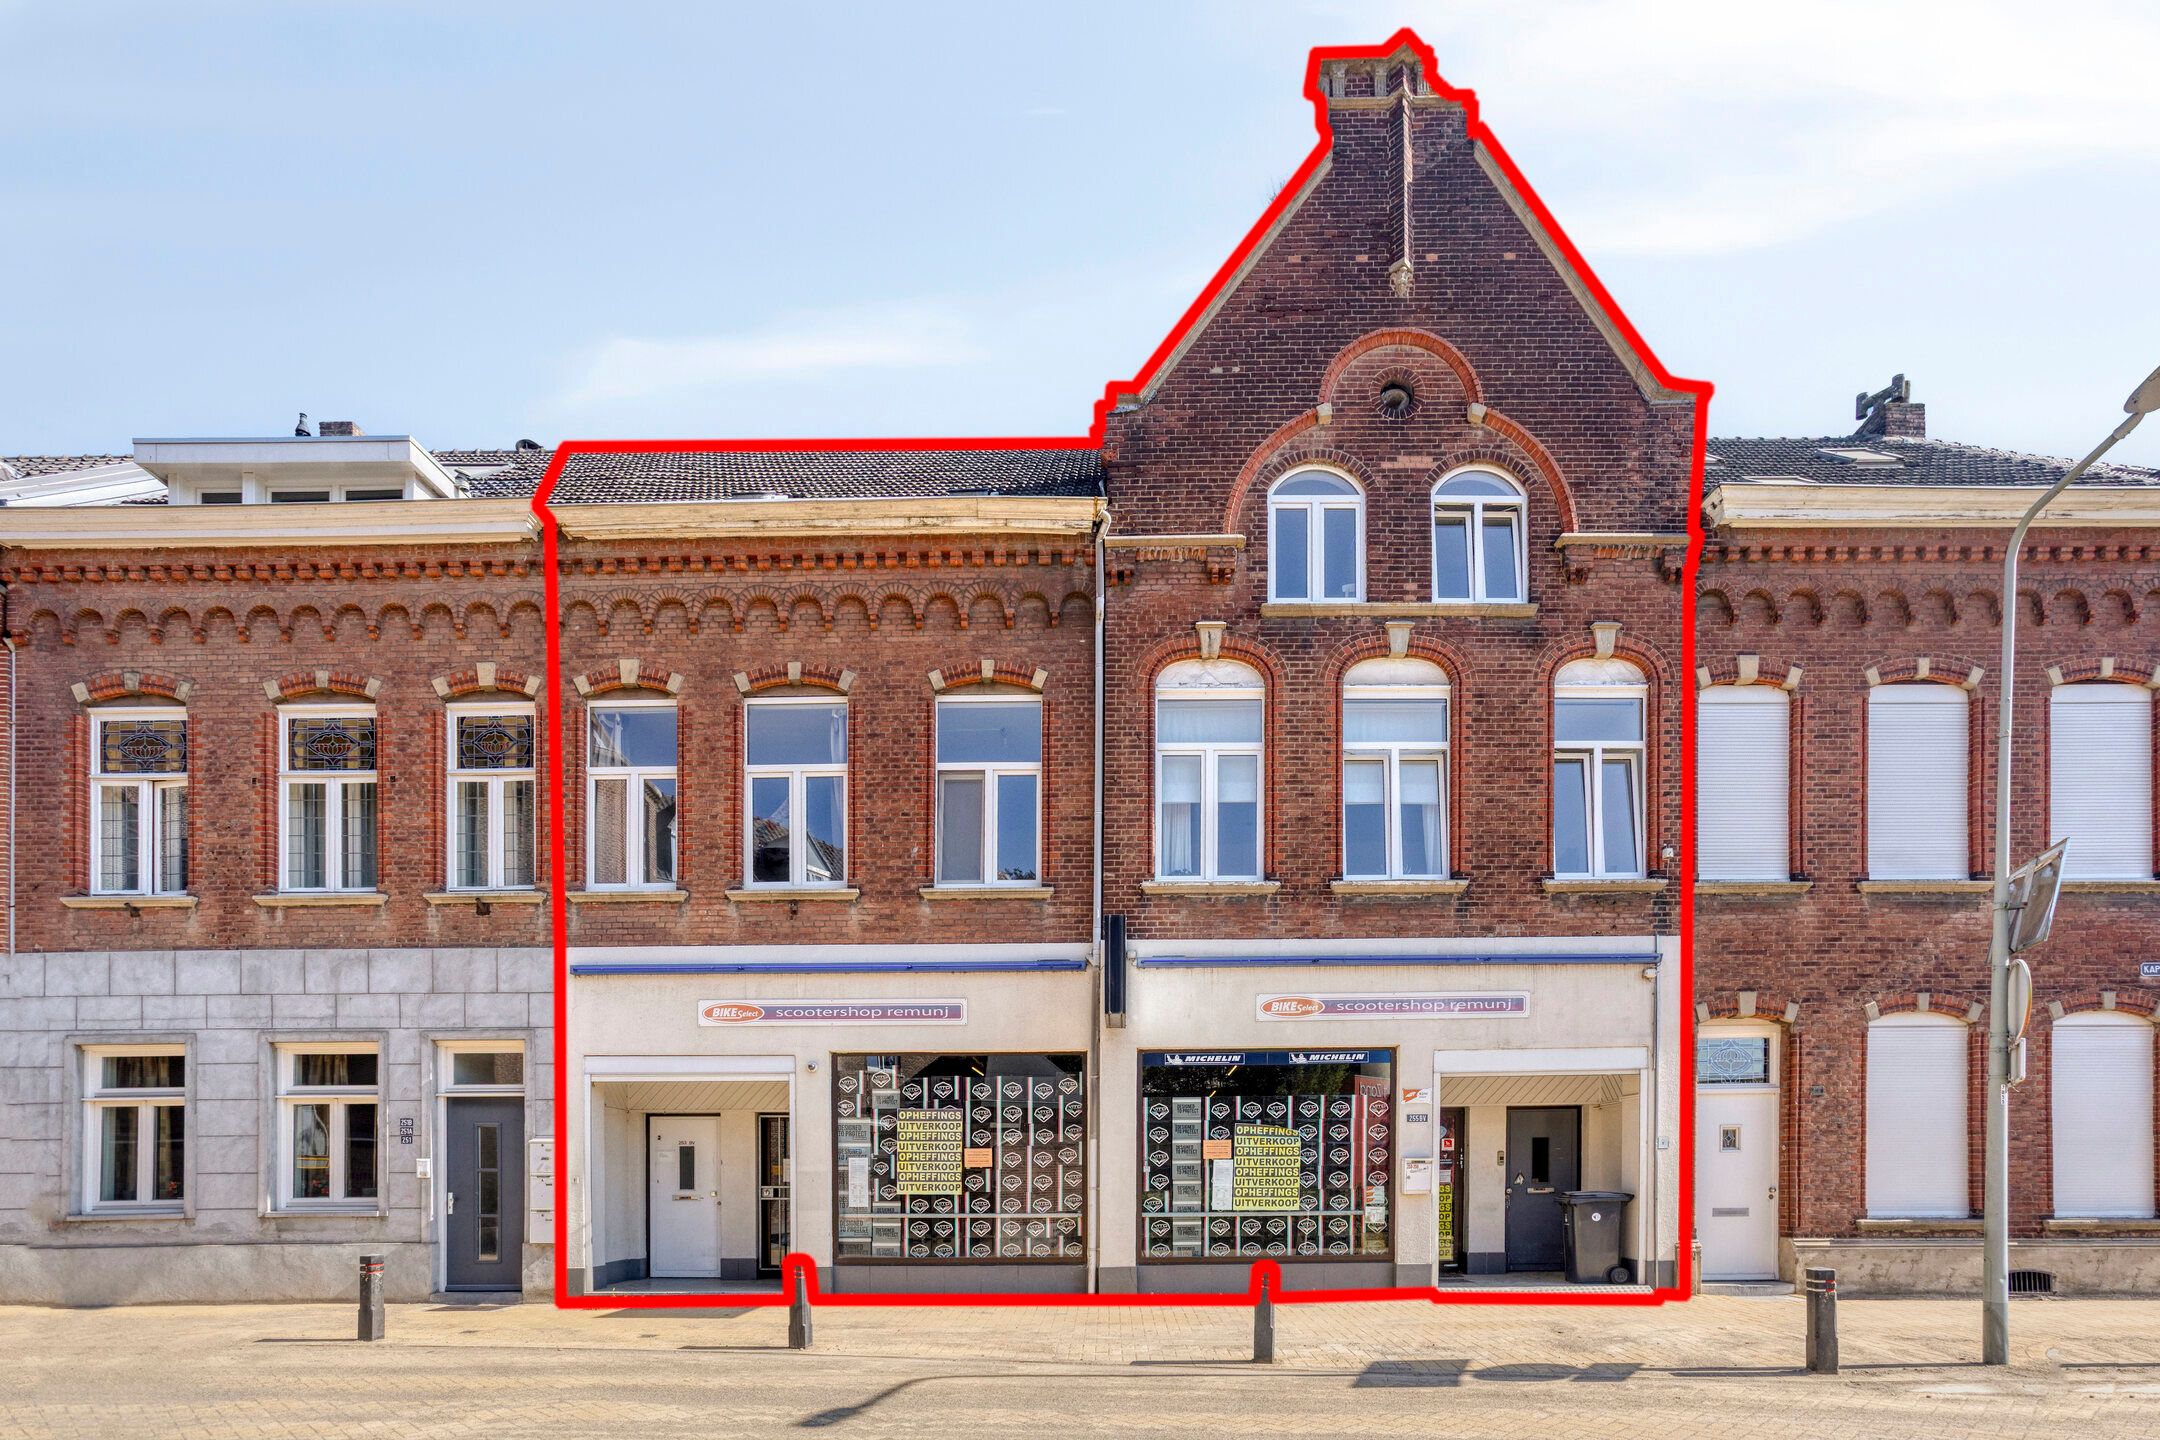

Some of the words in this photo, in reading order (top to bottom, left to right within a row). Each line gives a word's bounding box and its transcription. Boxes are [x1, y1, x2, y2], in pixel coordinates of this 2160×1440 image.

[1271, 1001, 1298, 1011] BIKE
[1297, 1004, 1318, 1013] Select
[1336, 1000, 1445, 1012] scootershop
[1450, 998, 1512, 1011] remunj
[712, 1008, 738, 1017] BIKE
[738, 1010, 758, 1018] Select
[776, 1007, 882, 1019] scootershop
[887, 1006, 949, 1018] remunj
[1236, 1126, 1298, 1136] OPHEFFINGS
[1235, 1188, 1298, 1196] OPHEFFINGS
